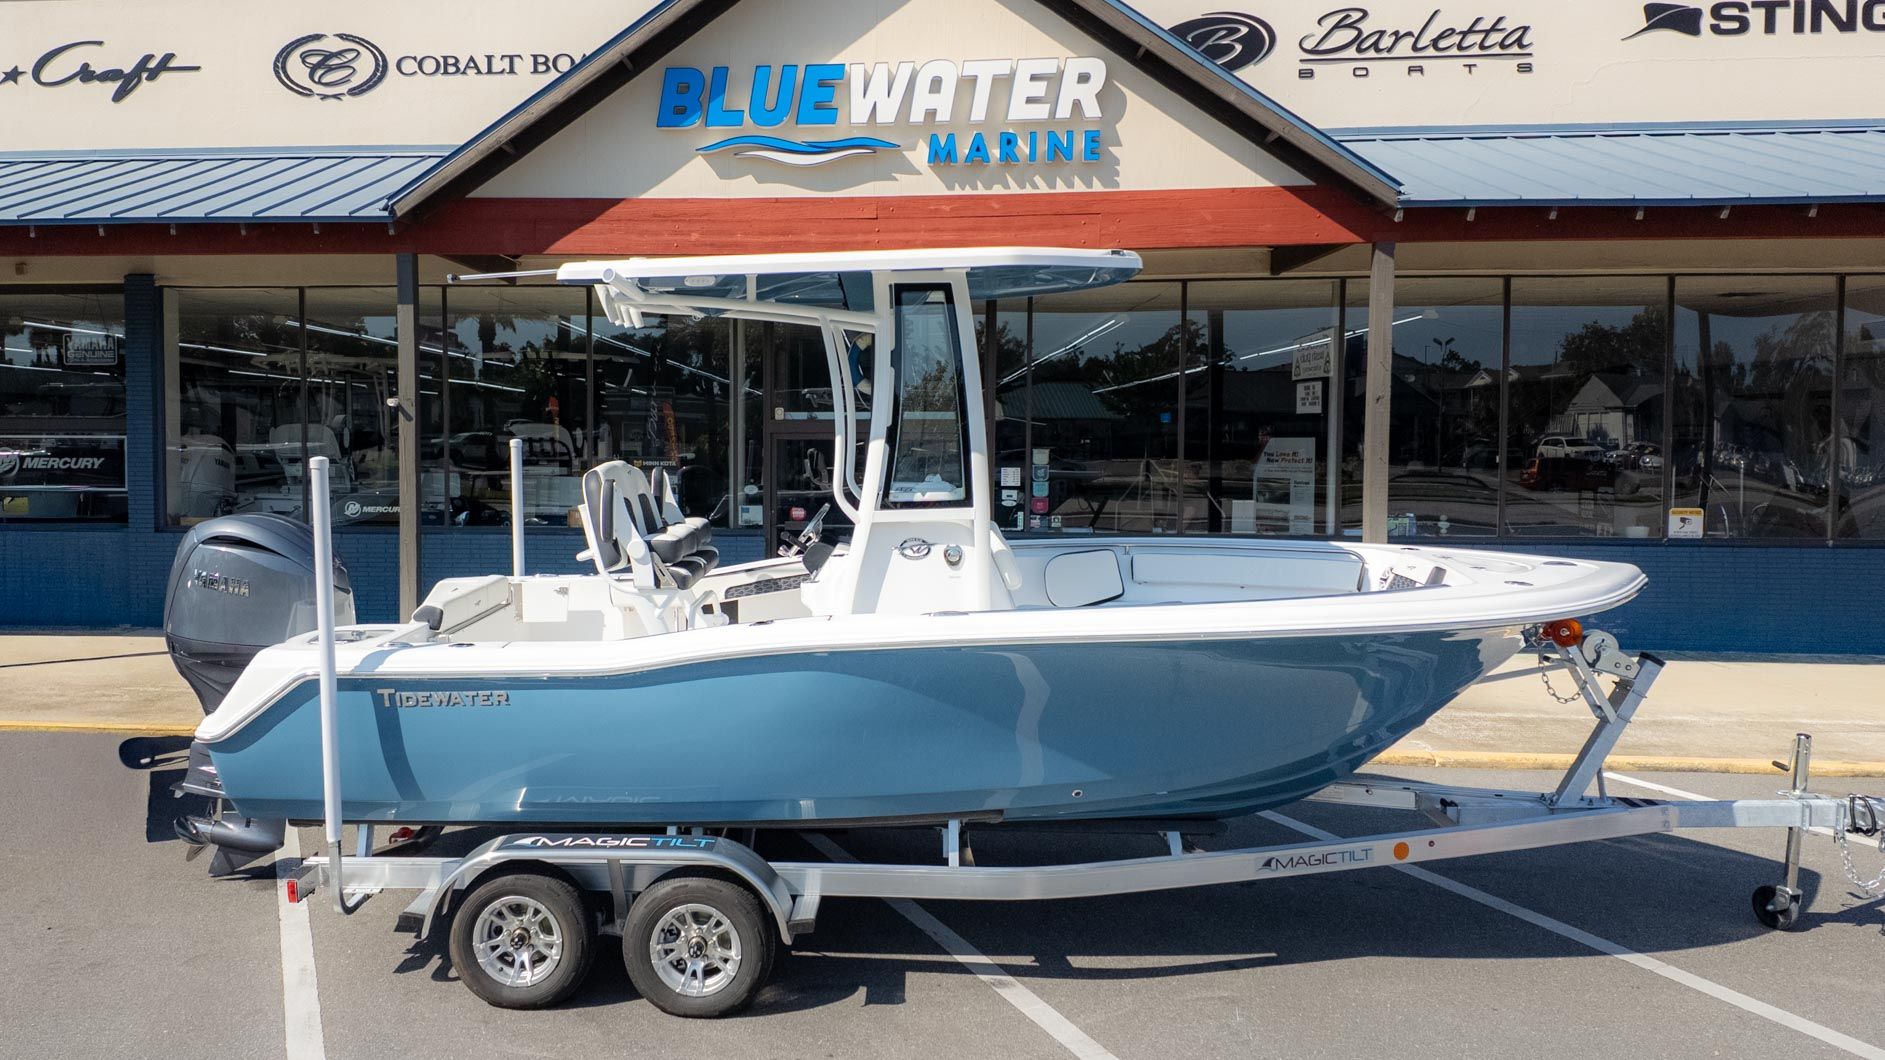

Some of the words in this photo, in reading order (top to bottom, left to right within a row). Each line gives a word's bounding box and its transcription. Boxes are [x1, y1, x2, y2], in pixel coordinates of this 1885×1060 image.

[1709, 0, 1885, 35] STING
[1299, 7, 1533, 55] Barletta
[32, 40, 201, 103] Craft
[396, 54, 523, 76] COBALT
[1298, 62, 1533, 79] BOATS
[656, 57, 1107, 128] BLUEWATER
[927, 130, 1101, 165] MARINE
[66, 337, 115, 350] YAMAHA
[67, 350, 115, 358] GENUINE
[22, 457, 105, 469] MERCURY
[376, 688, 511, 708] TIDEWATER
